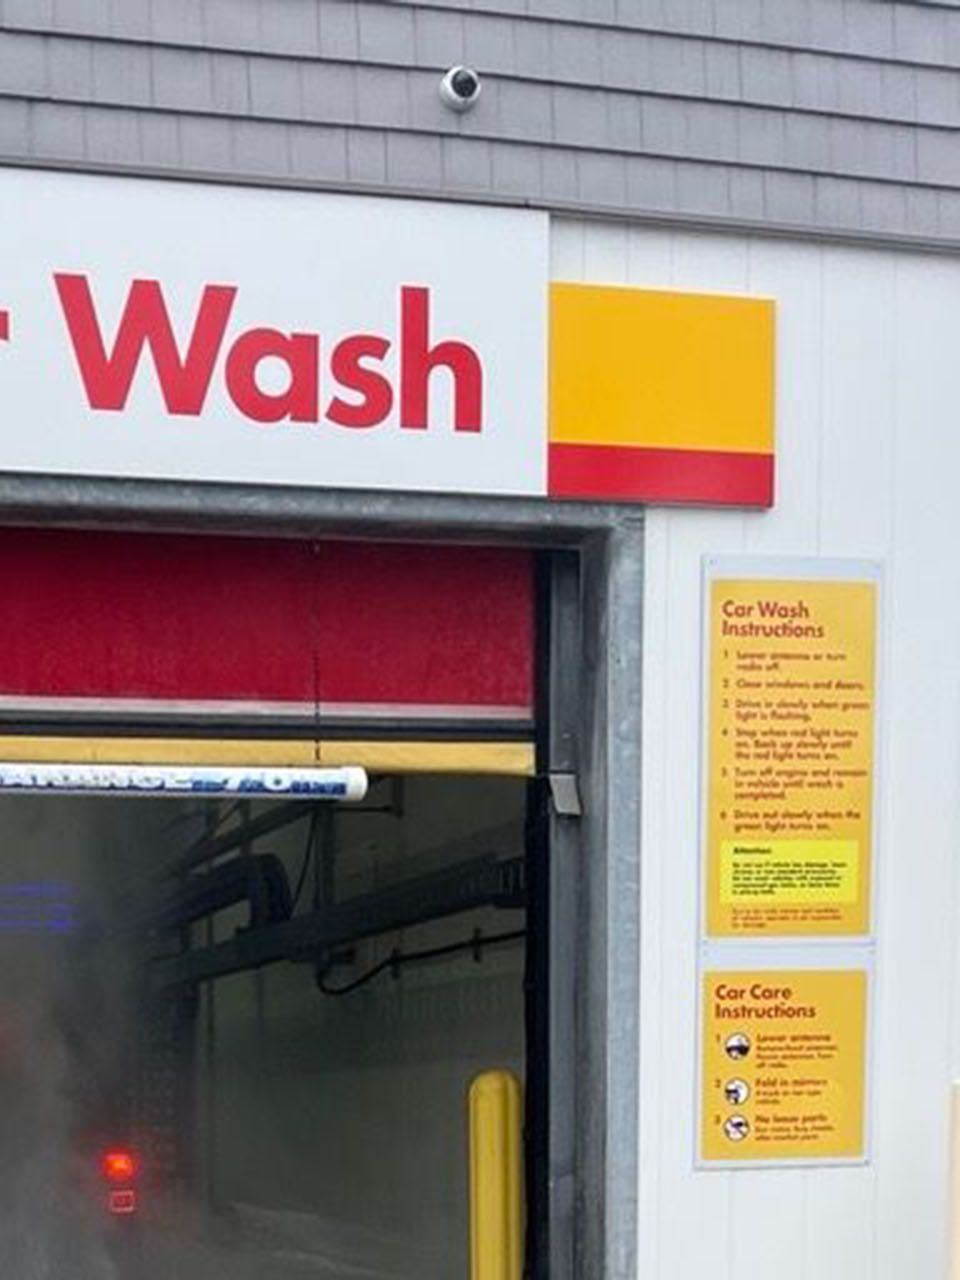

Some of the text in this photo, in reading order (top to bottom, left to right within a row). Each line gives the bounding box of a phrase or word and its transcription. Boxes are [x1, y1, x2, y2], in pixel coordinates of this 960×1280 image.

[52, 272, 484, 434] Wash
[722, 600, 810, 619] Car Wash
[722, 619, 825, 639] Instructions
[715, 984, 792, 1000] Car Care
[715, 1001, 817, 1020] Instructions
